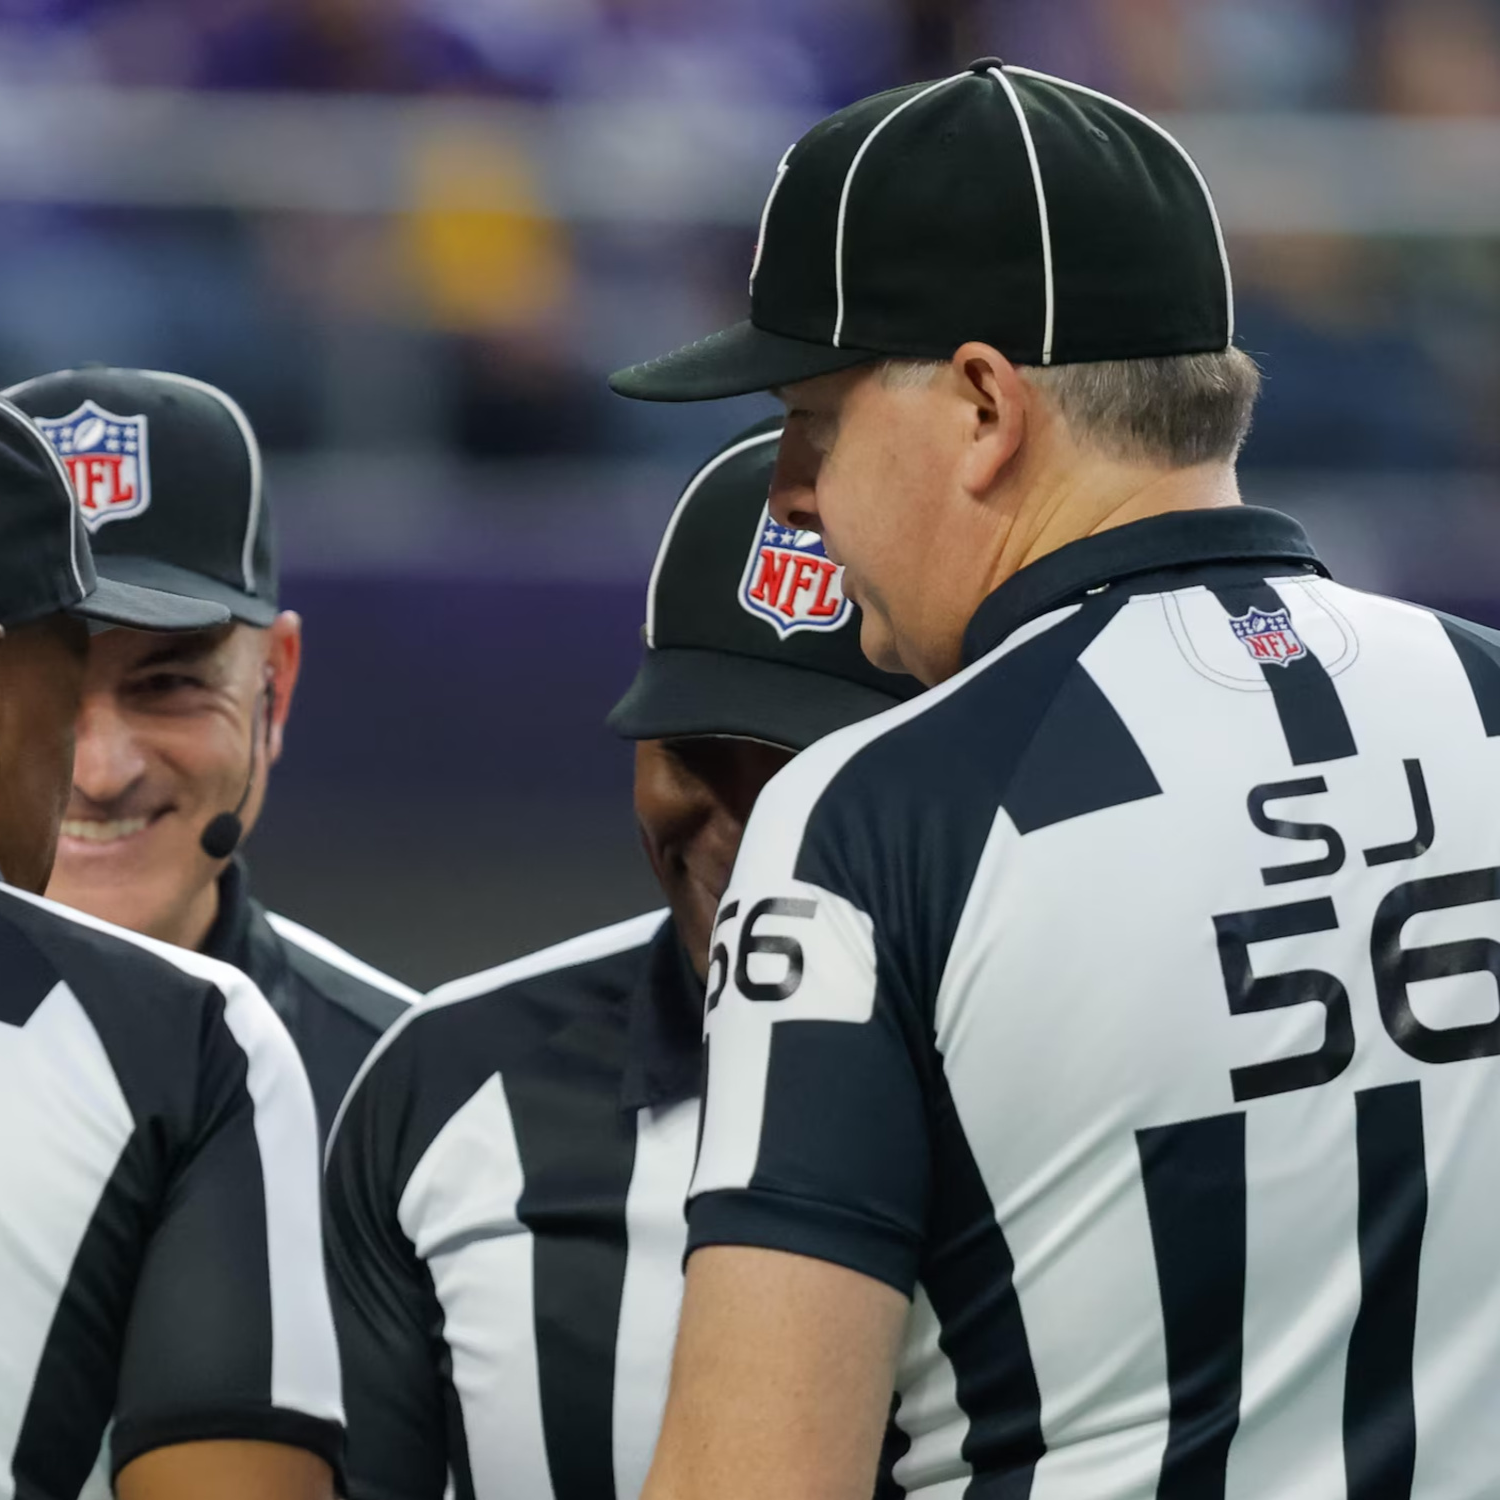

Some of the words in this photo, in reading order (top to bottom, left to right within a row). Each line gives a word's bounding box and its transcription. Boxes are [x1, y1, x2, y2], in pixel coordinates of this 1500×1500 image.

[749, 548, 840, 618] NFL
[1245, 631, 1300, 659] NFL
[1247, 758, 1435, 886] SJ
[1213, 866, 1500, 1103] 56
